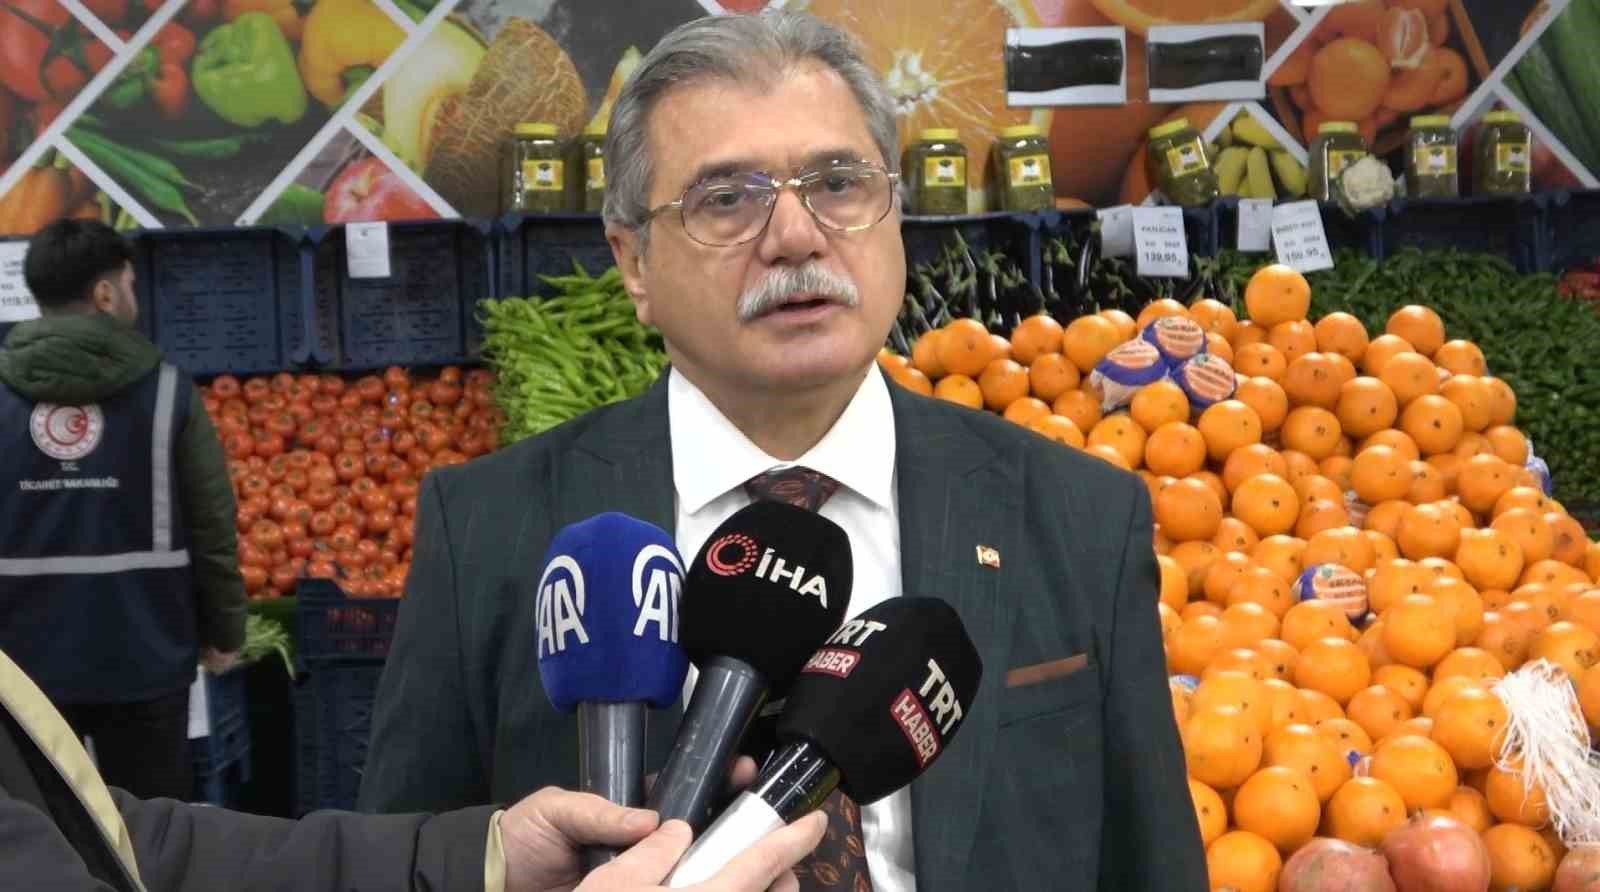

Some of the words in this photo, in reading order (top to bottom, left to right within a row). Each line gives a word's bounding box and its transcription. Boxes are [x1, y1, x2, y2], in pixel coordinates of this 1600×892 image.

[755, 547, 828, 609] İHA
[538, 579, 590, 659] AA
[894, 695, 938, 763] HABER
[919, 658, 963, 735] TRT
